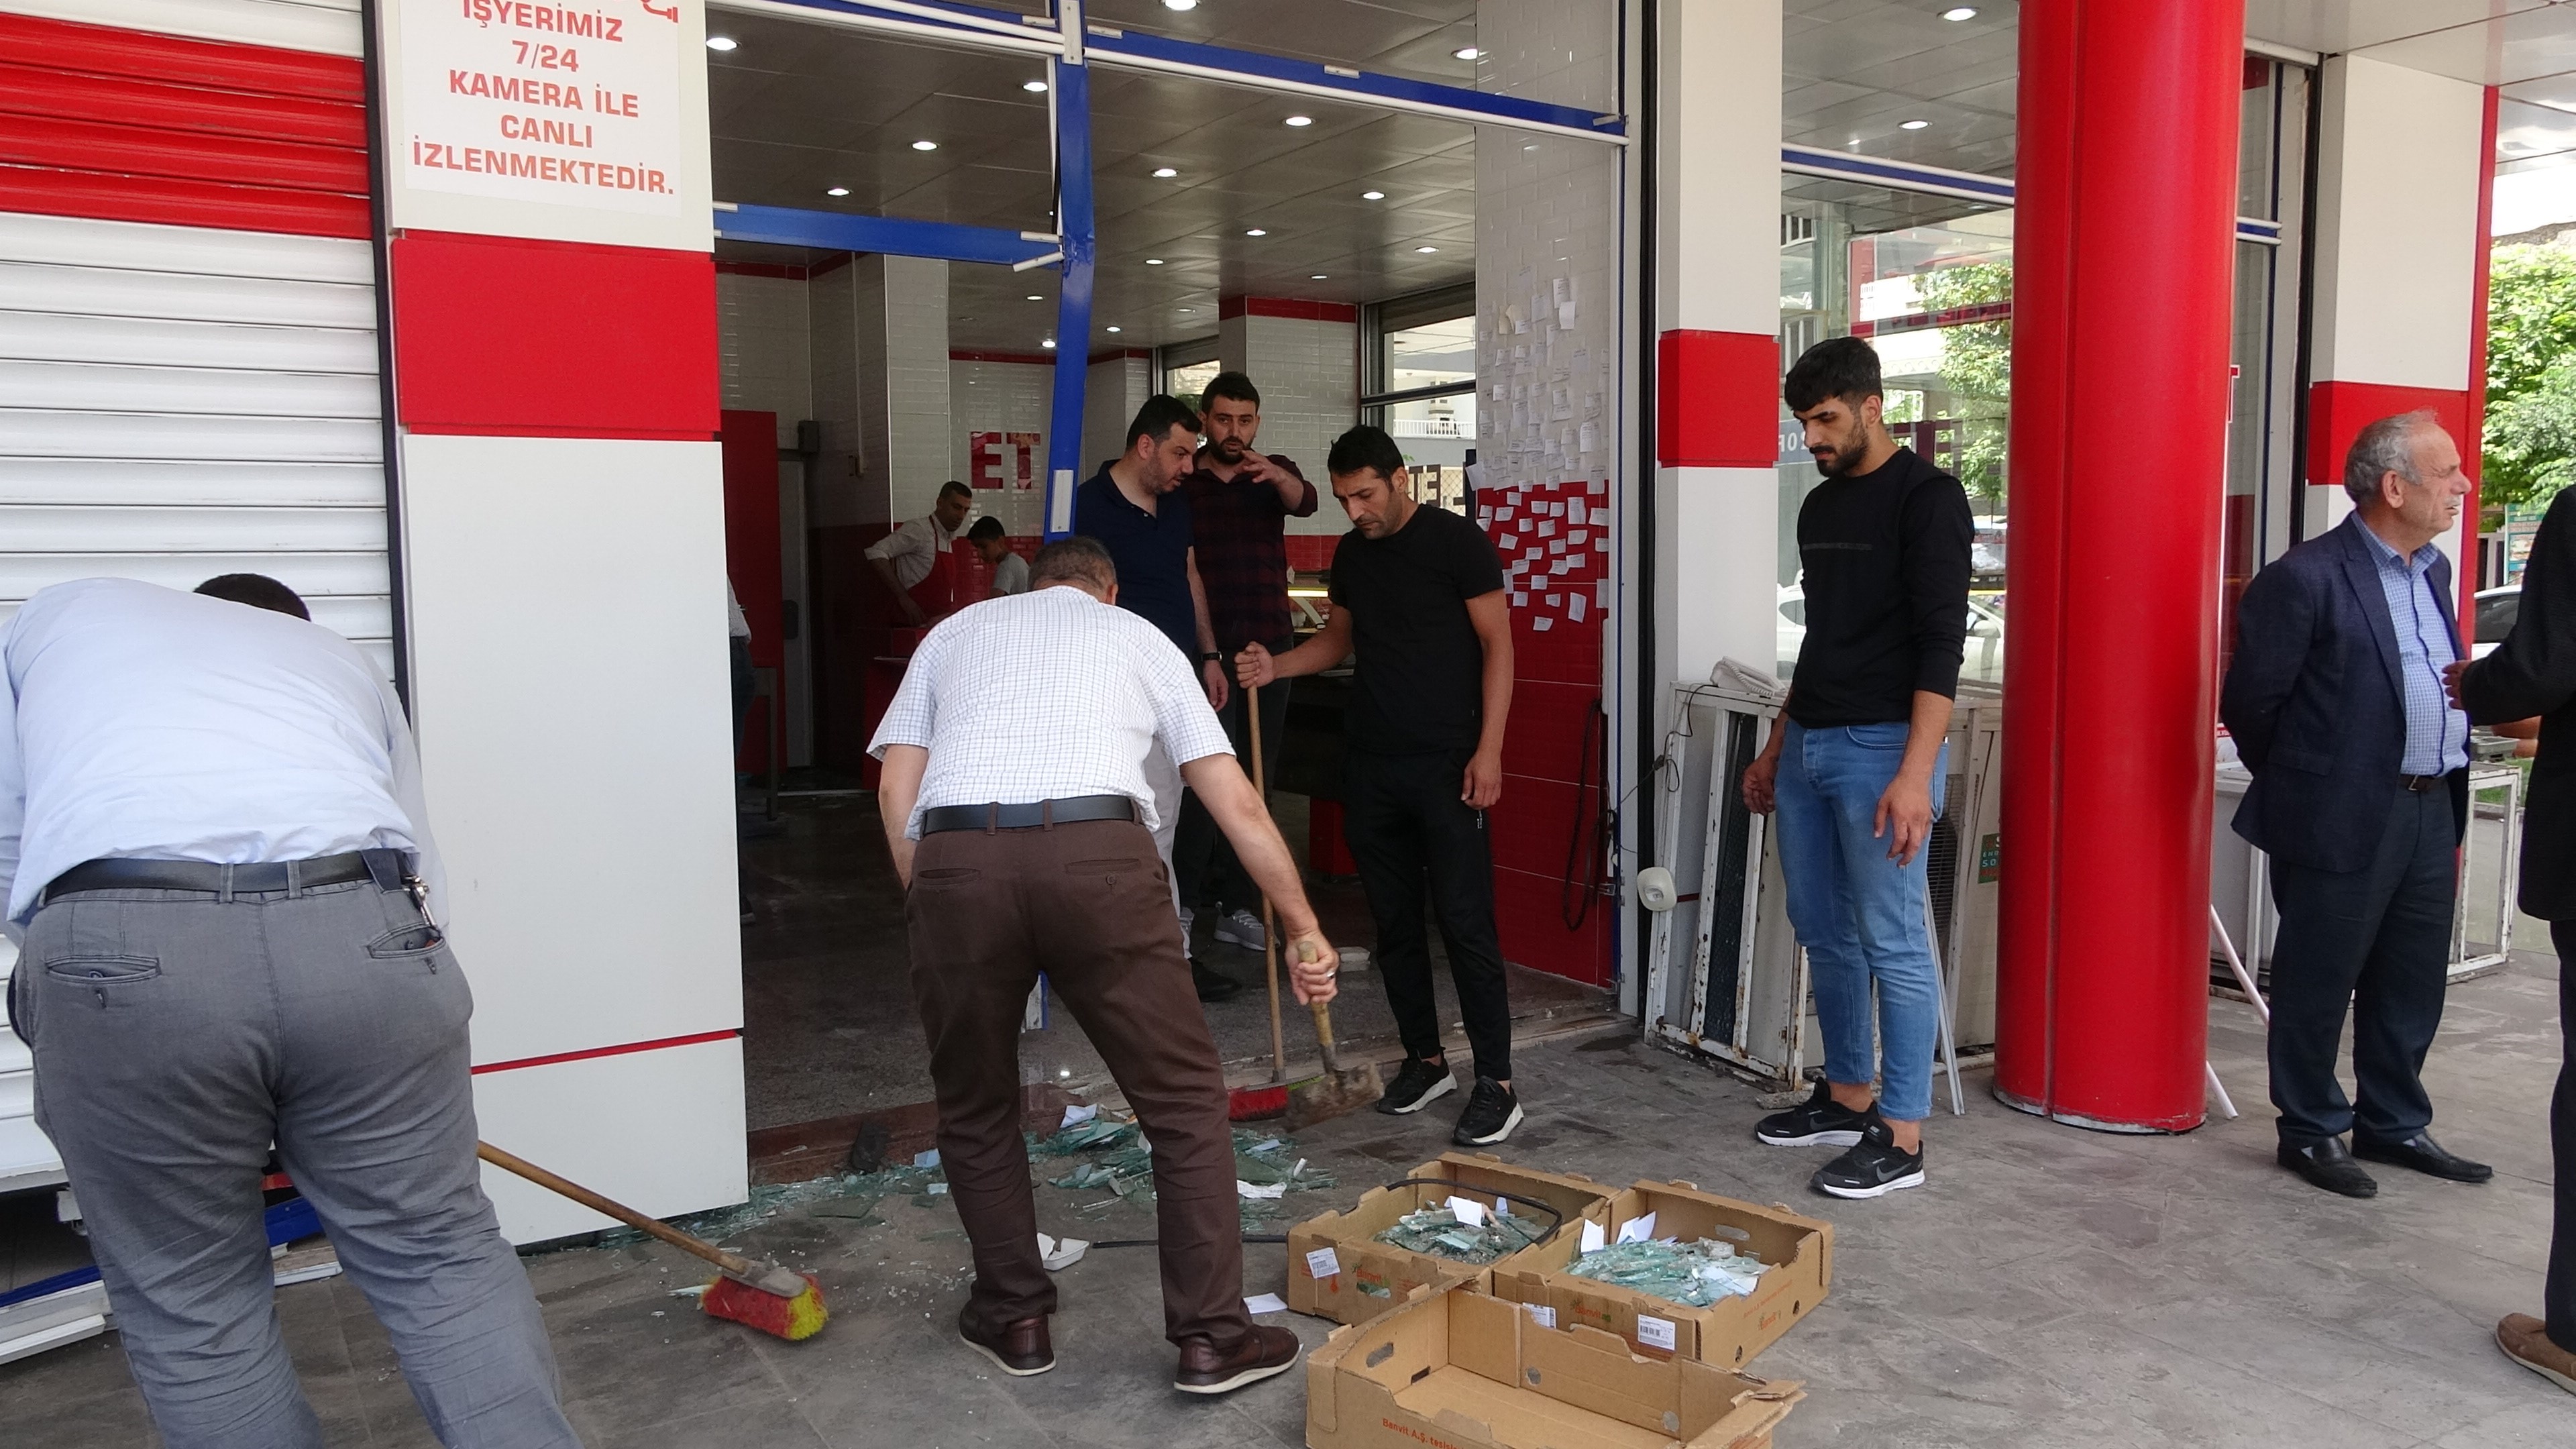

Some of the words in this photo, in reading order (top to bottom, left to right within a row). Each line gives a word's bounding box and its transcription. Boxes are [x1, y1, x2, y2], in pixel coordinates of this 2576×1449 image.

[511, 40, 579, 72] 7/24
[449, 68, 584, 111] KAMERA
[594, 83, 639, 119] İLE
[500, 114, 593, 148] CANLI
[413, 134, 674, 195] İZLENMEKTEDİR.
[971, 432, 1040, 489] ET
[1382, 1417, 1409, 1436] Banvit
